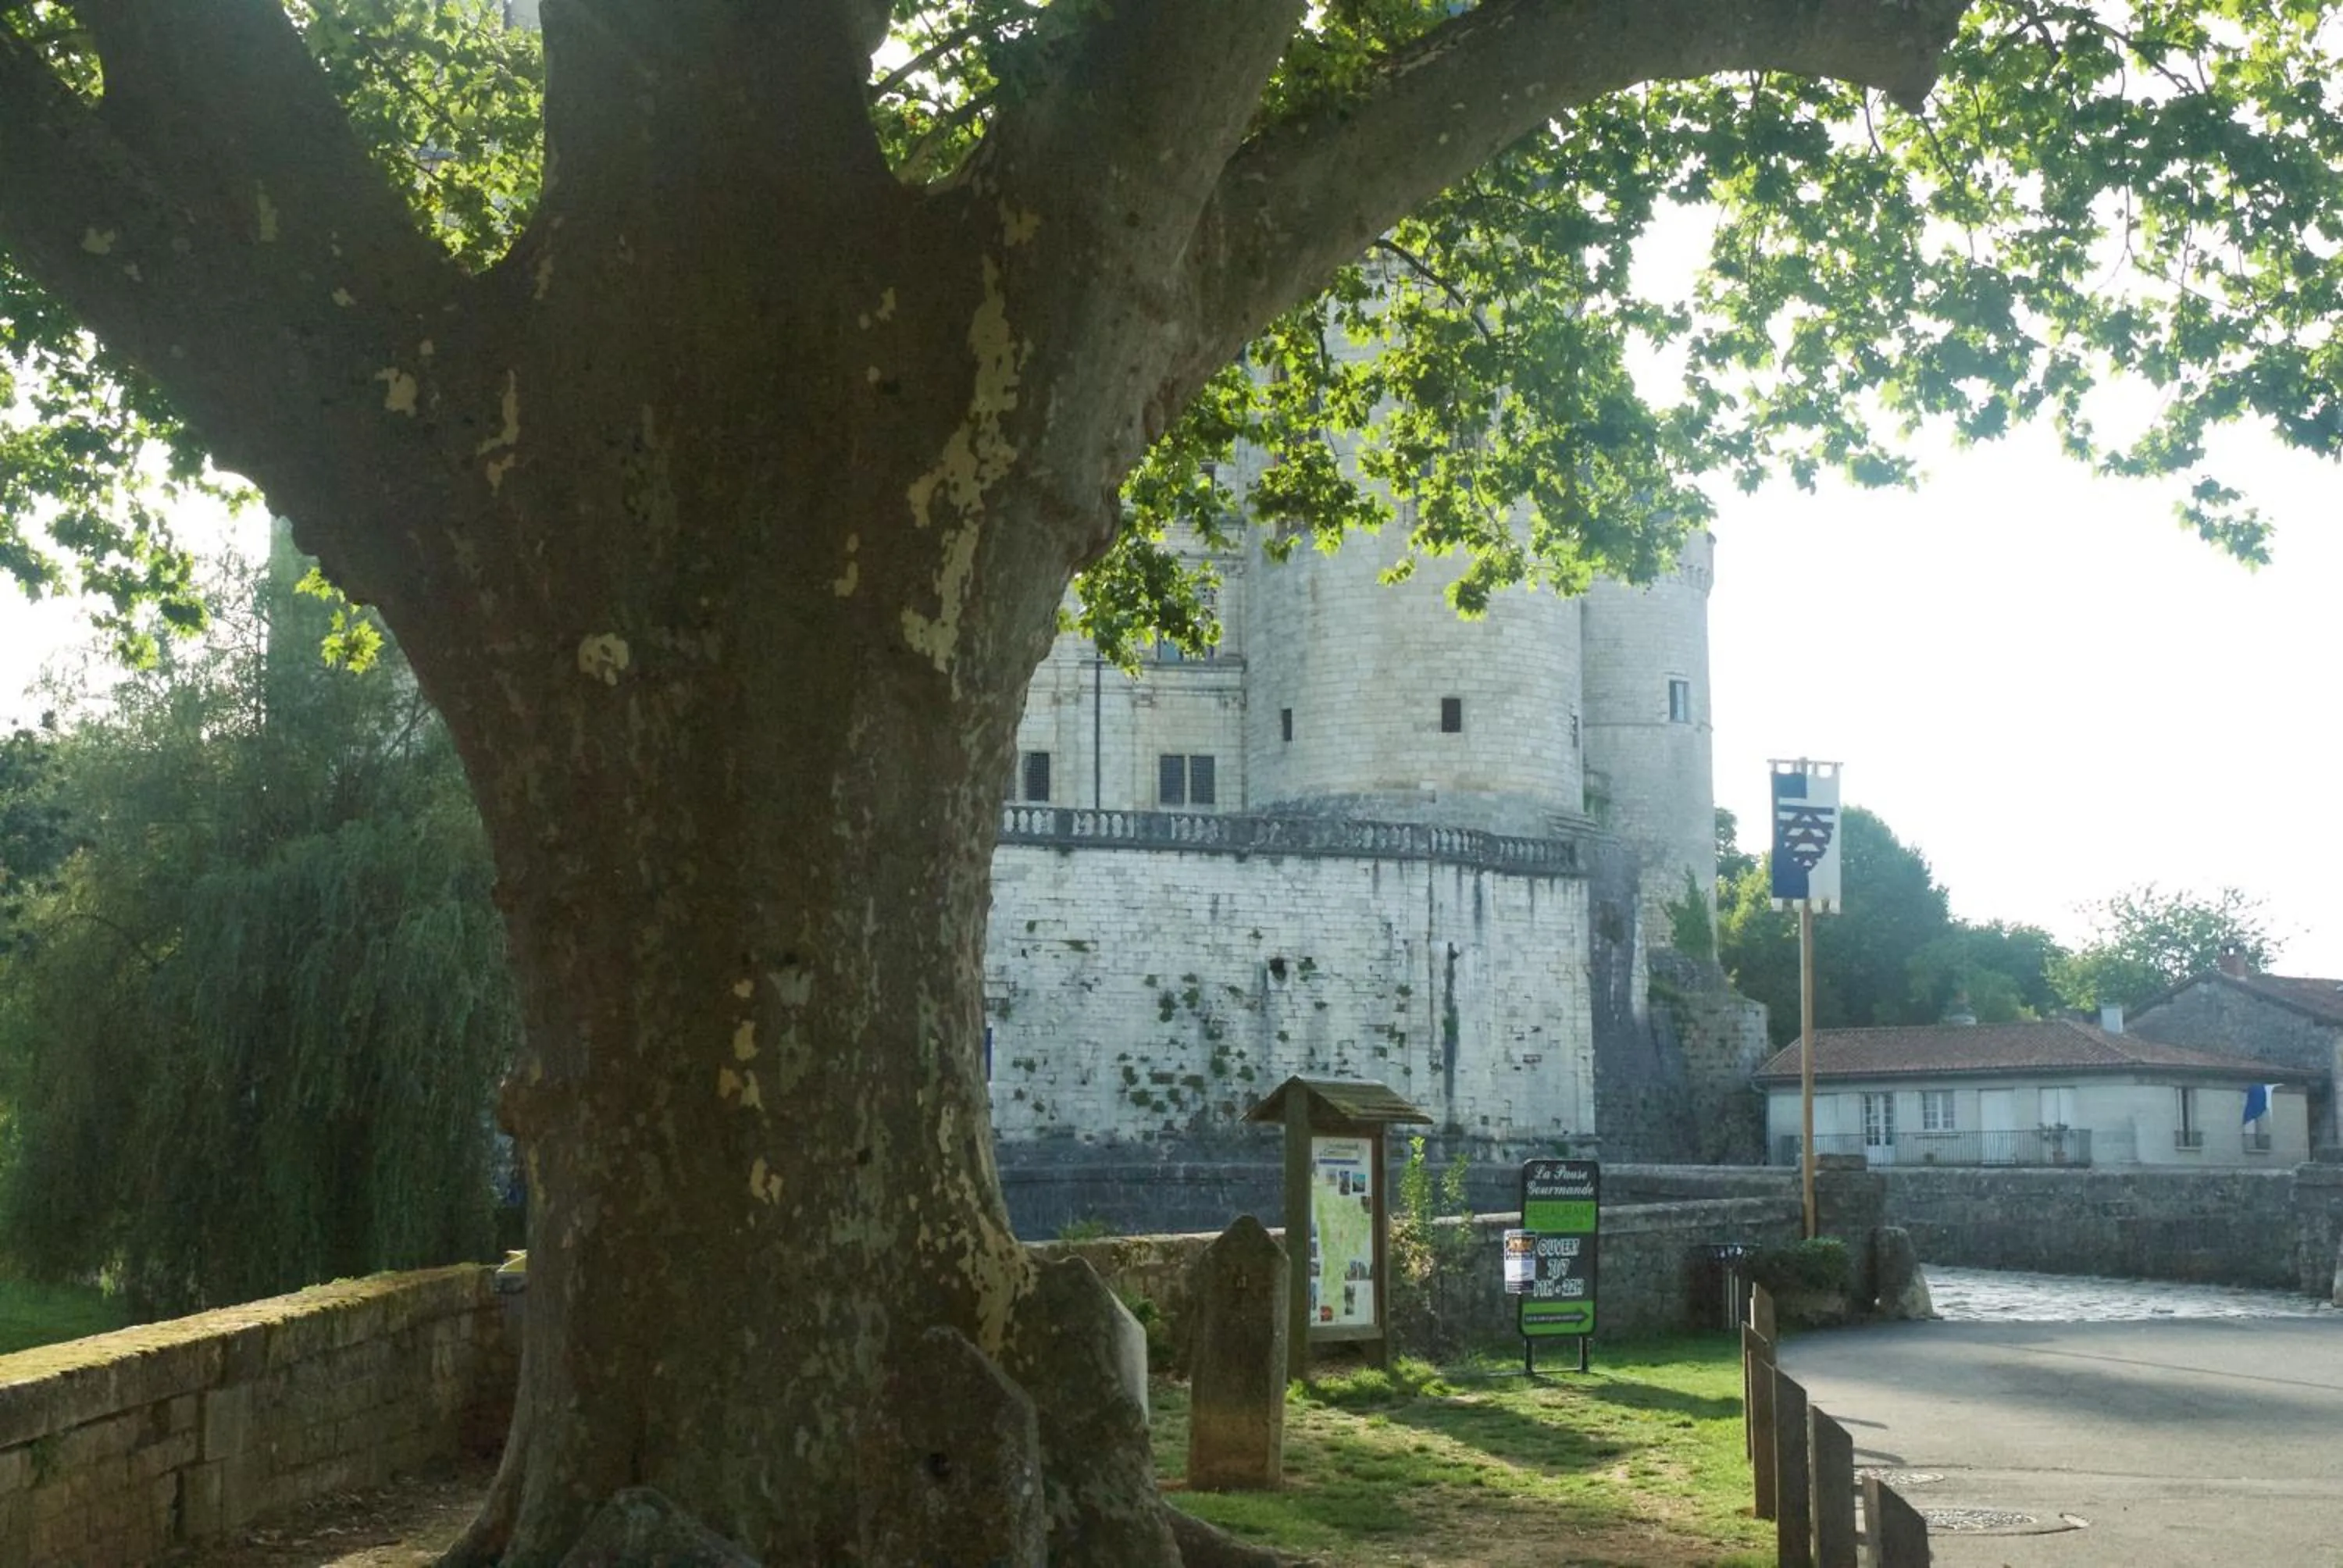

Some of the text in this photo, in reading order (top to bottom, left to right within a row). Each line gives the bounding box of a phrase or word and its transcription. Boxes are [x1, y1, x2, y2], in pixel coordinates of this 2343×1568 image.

[1534, 1164, 1588, 1179] La Pause
[1527, 1180, 1594, 1196] Gourmande
[1537, 1238, 1580, 1256] OUVERT
[1561, 1278, 1585, 1296] 22H
